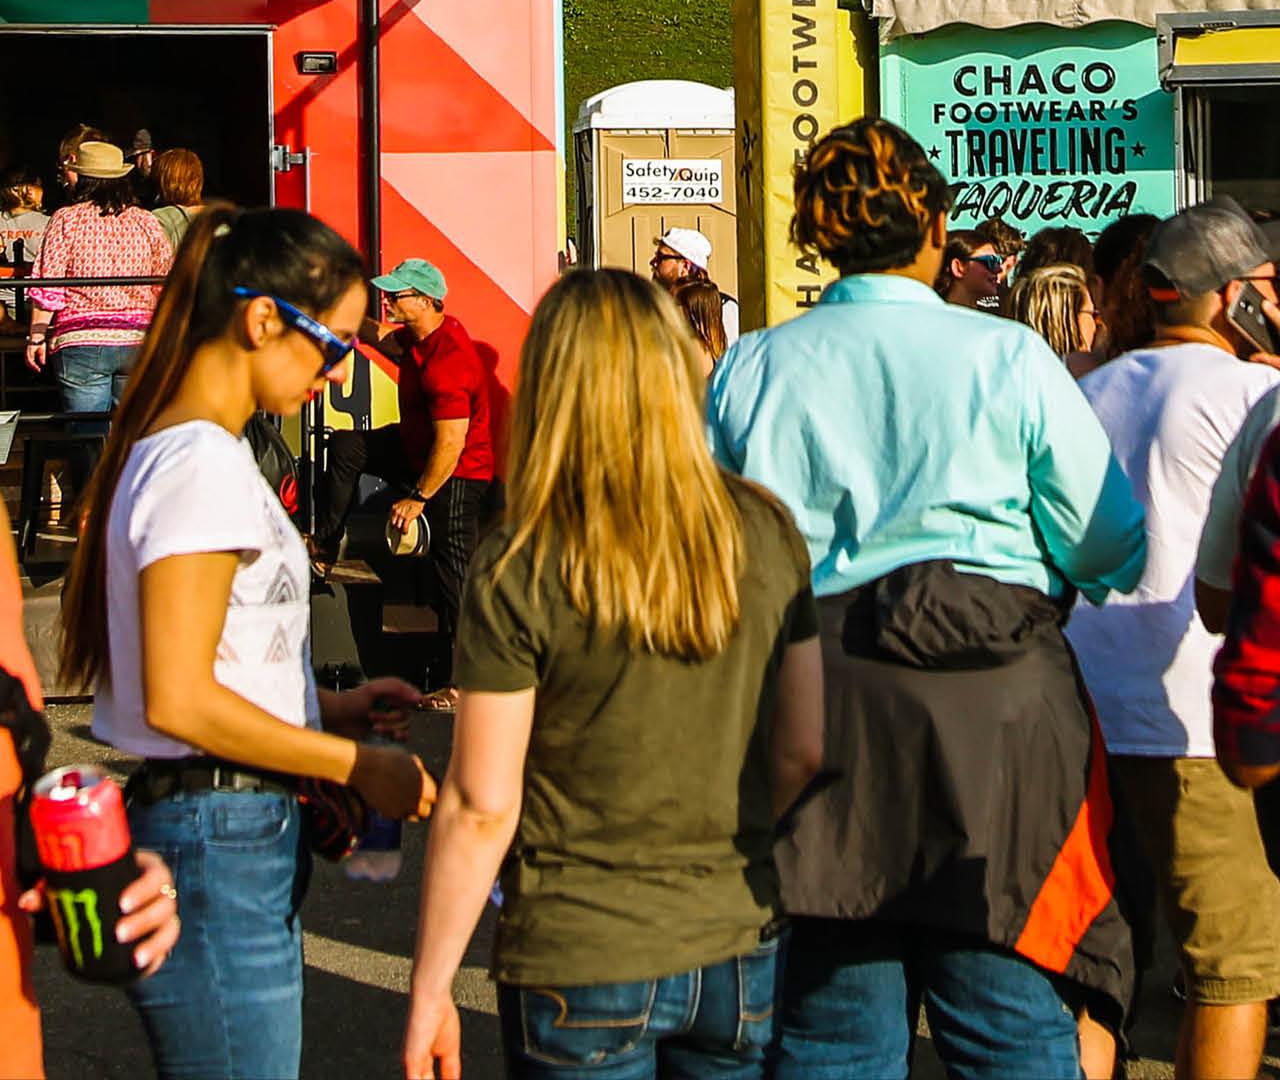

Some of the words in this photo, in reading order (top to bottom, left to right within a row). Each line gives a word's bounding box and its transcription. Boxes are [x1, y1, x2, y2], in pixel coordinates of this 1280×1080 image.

[954, 62, 1116, 97] CHACO
[934, 100, 1138, 125] FOOTWEAR'S
[946, 127, 1126, 177] TRAVELING
[626, 187, 719, 198] 452-7040
[948, 180, 1138, 221] TAQUERIA
